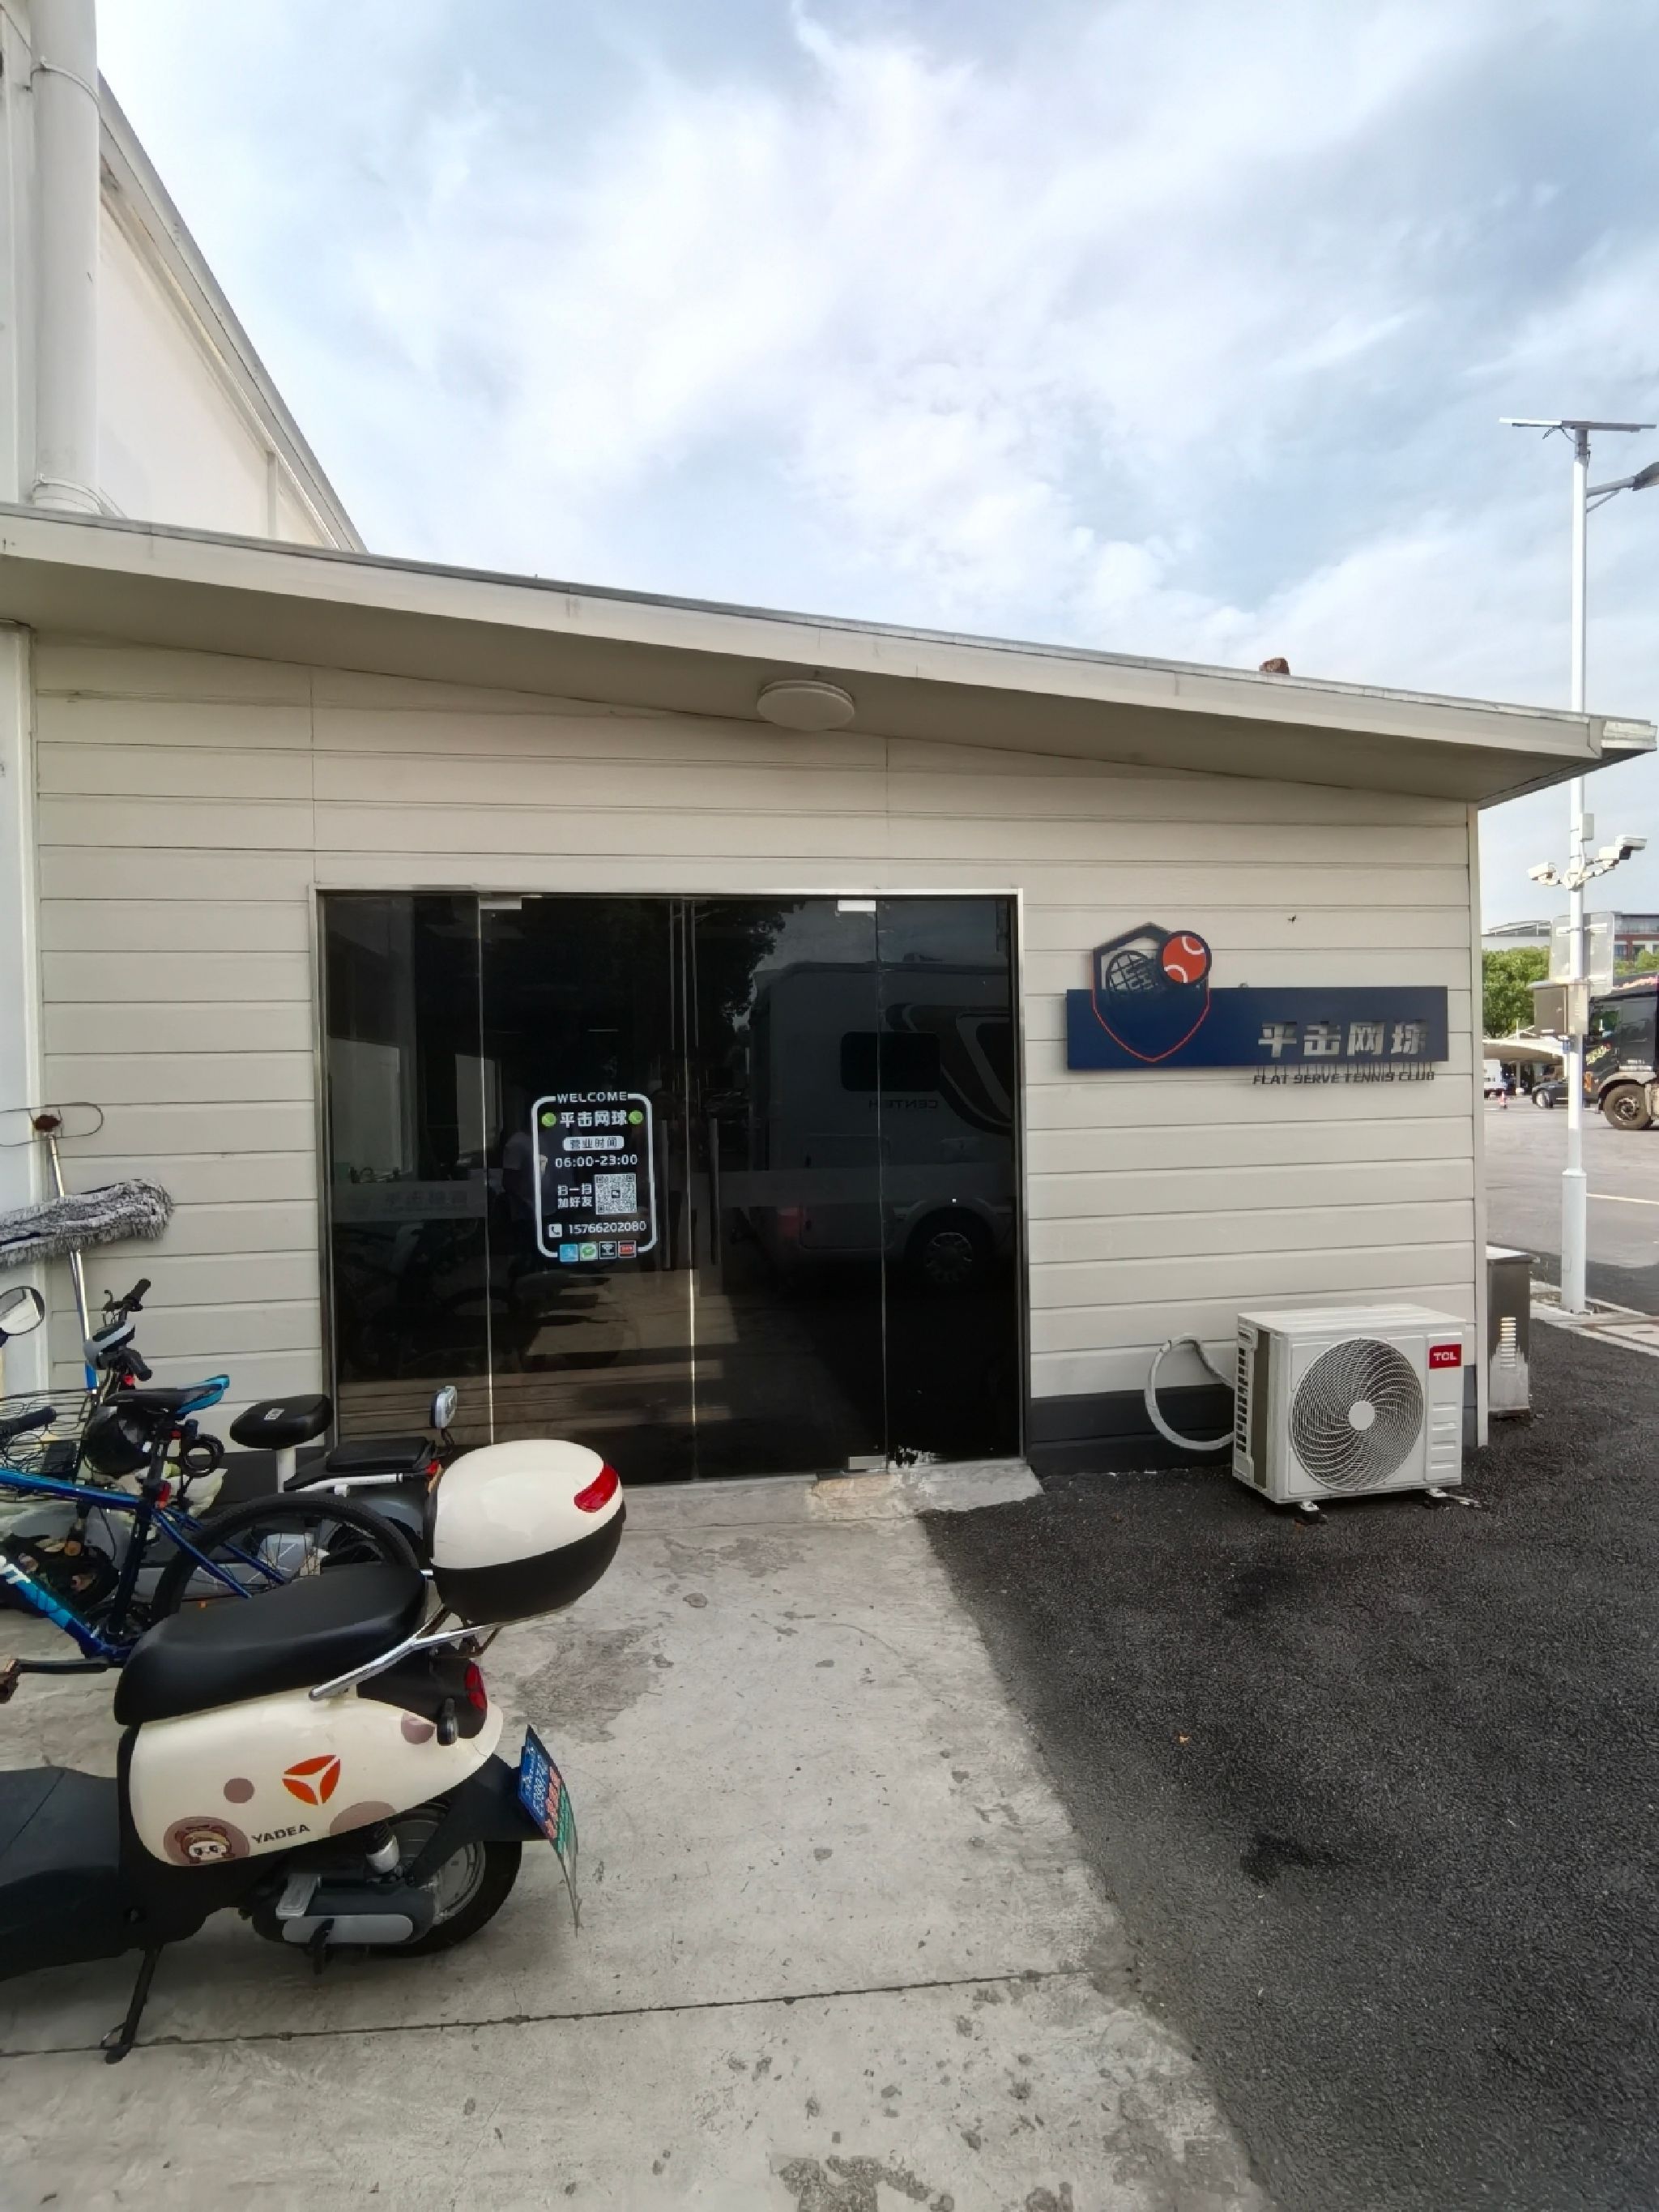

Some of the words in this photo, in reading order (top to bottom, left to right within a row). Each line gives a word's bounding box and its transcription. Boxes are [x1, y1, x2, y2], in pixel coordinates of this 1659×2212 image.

[1257, 1021, 1427, 1058] 平击网球
[1252, 1074, 1289, 1084] FLAT
[1293, 1073, 1340, 1084] SERVE
[1341, 1072, 1394, 1083] TENNIS
[1398, 1071, 1435, 1081] CLUB
[557, 1091, 628, 1103] WELCOME
[560, 1110, 628, 1128] 平击网球
[569, 1137, 617, 1149] 营业时间
[555, 1154, 638, 1168] 06:00-23:00
[557, 1197, 593, 1209] 加好友
[1433, 1351, 1458, 1361] TCL
[250, 1824, 310, 1843] YADEA
